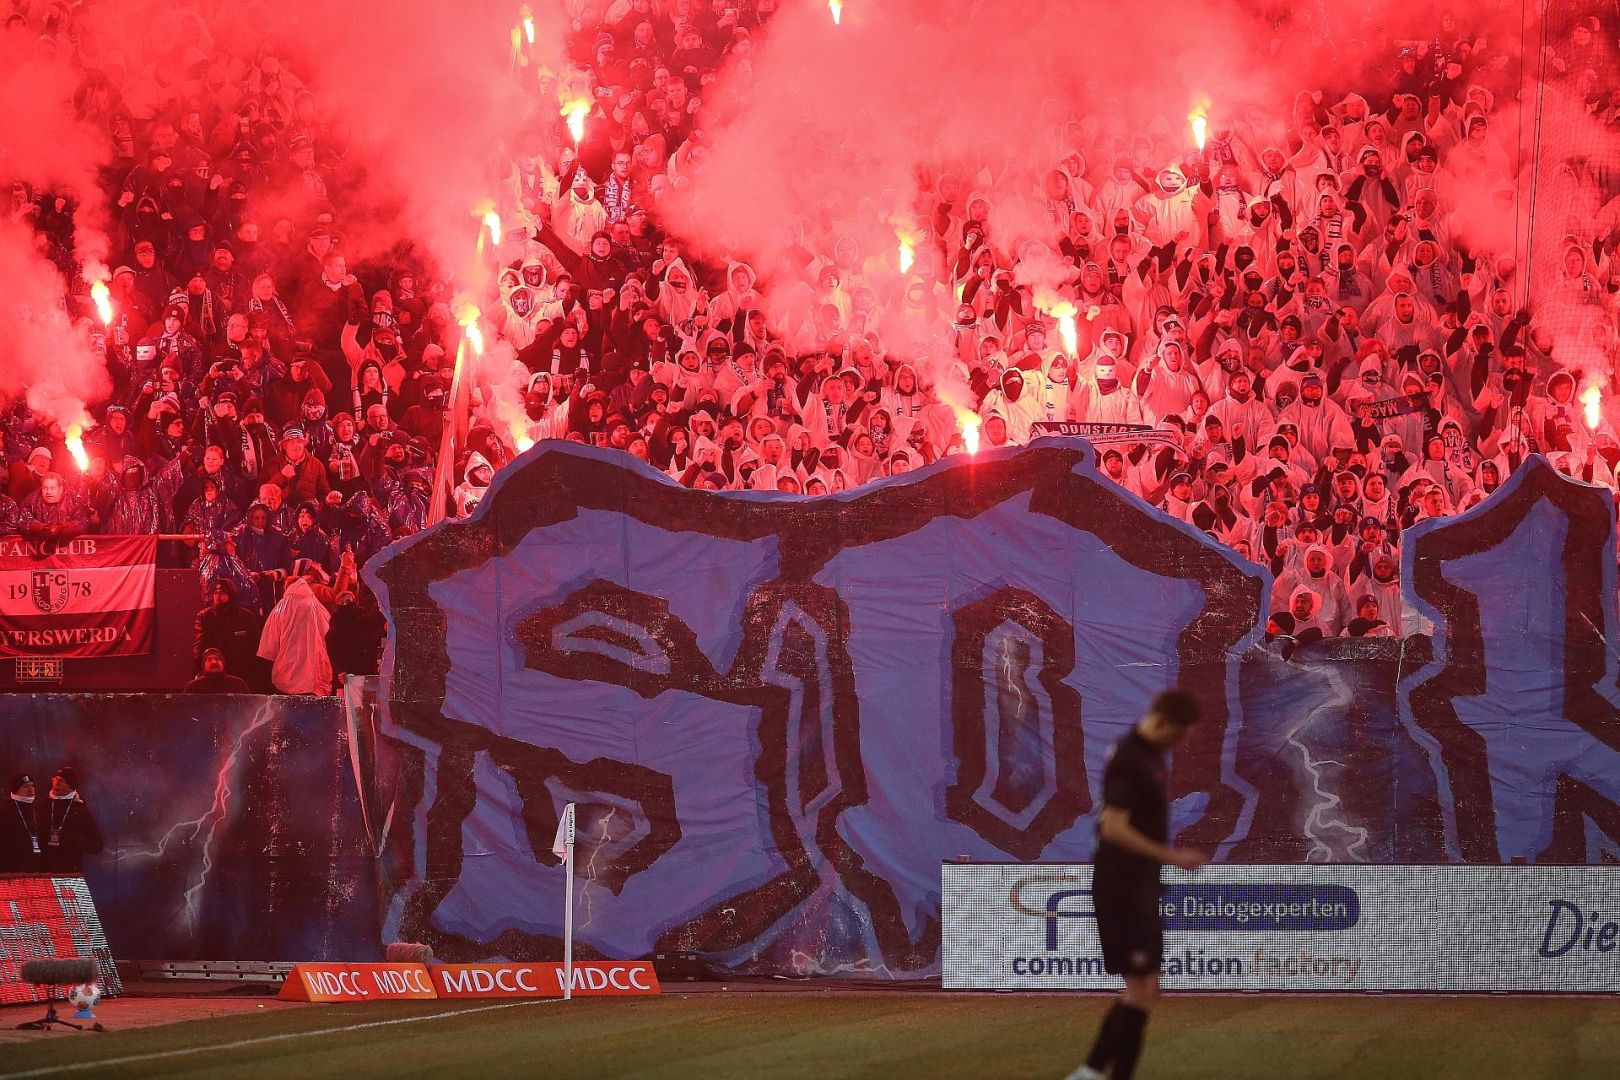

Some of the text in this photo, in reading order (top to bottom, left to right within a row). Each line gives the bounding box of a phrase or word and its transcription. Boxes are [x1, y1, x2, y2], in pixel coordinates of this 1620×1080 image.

[0, 539, 97, 557] FANCLUB
[8, 581, 92, 600] 19 78
[1183, 896, 1348, 922] Dialogexperten
[442, 966, 651, 993] MDCC MDCC
[1253, 949, 1362, 984] factory
[304, 968, 431, 996] MDCC MDCC
